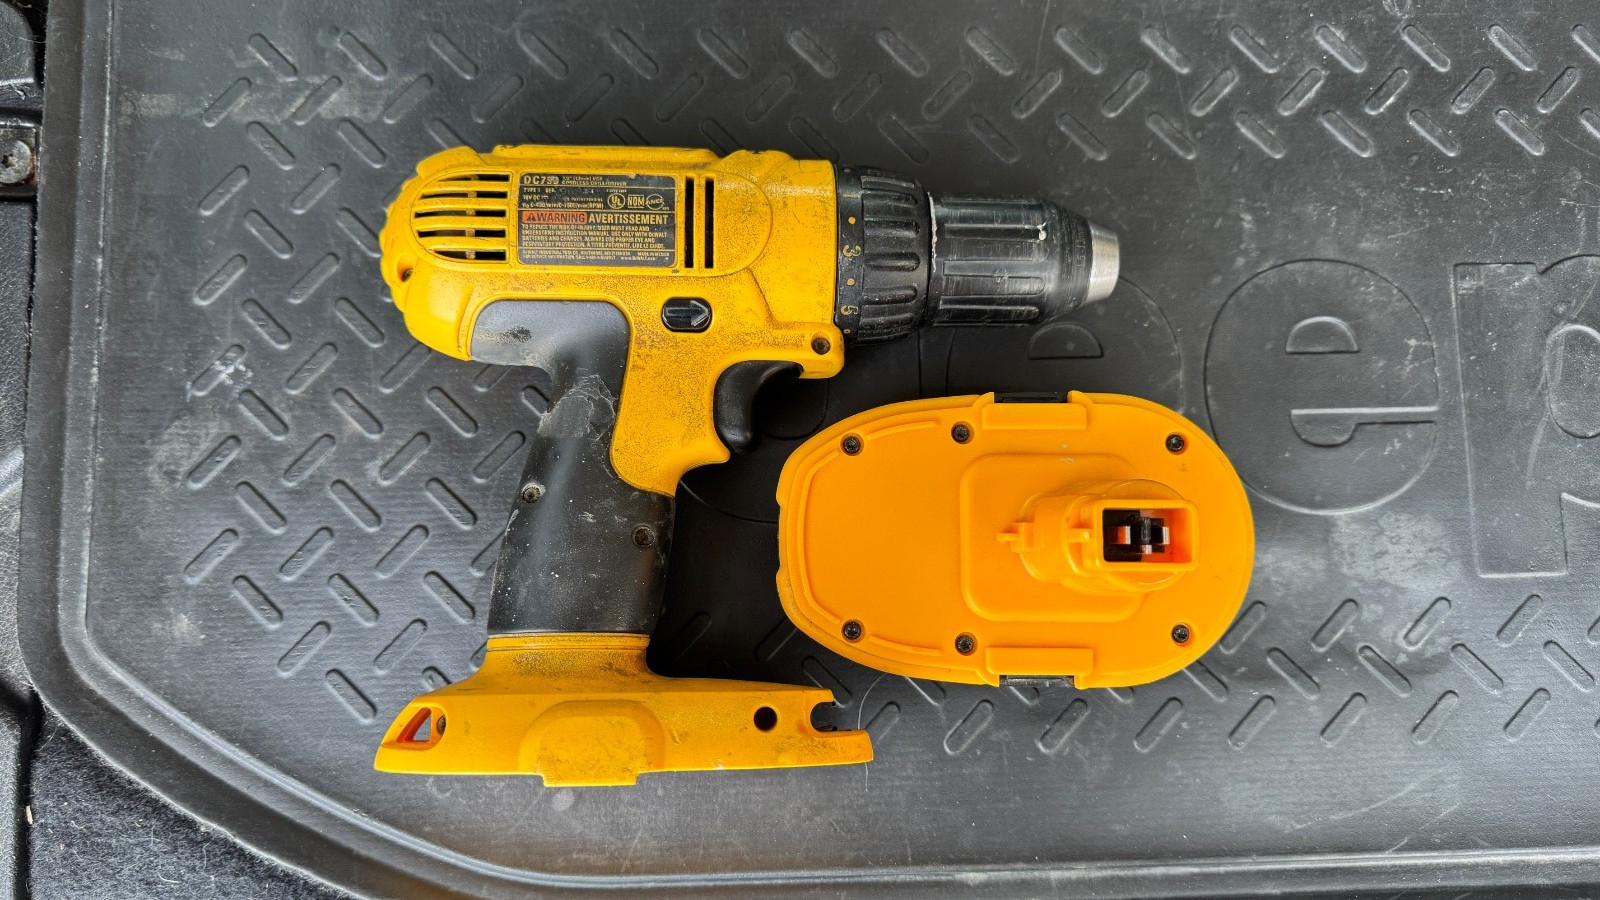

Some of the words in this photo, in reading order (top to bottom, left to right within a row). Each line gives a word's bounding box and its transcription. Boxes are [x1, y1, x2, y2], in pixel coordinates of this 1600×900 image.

[628, 196, 645, 206] NOM
[537, 213, 585, 223] WARNING
[588, 213, 669, 225] AVERTISSEMENT
[842, 244, 862, 258] 3
[840, 304, 860, 317] 5
